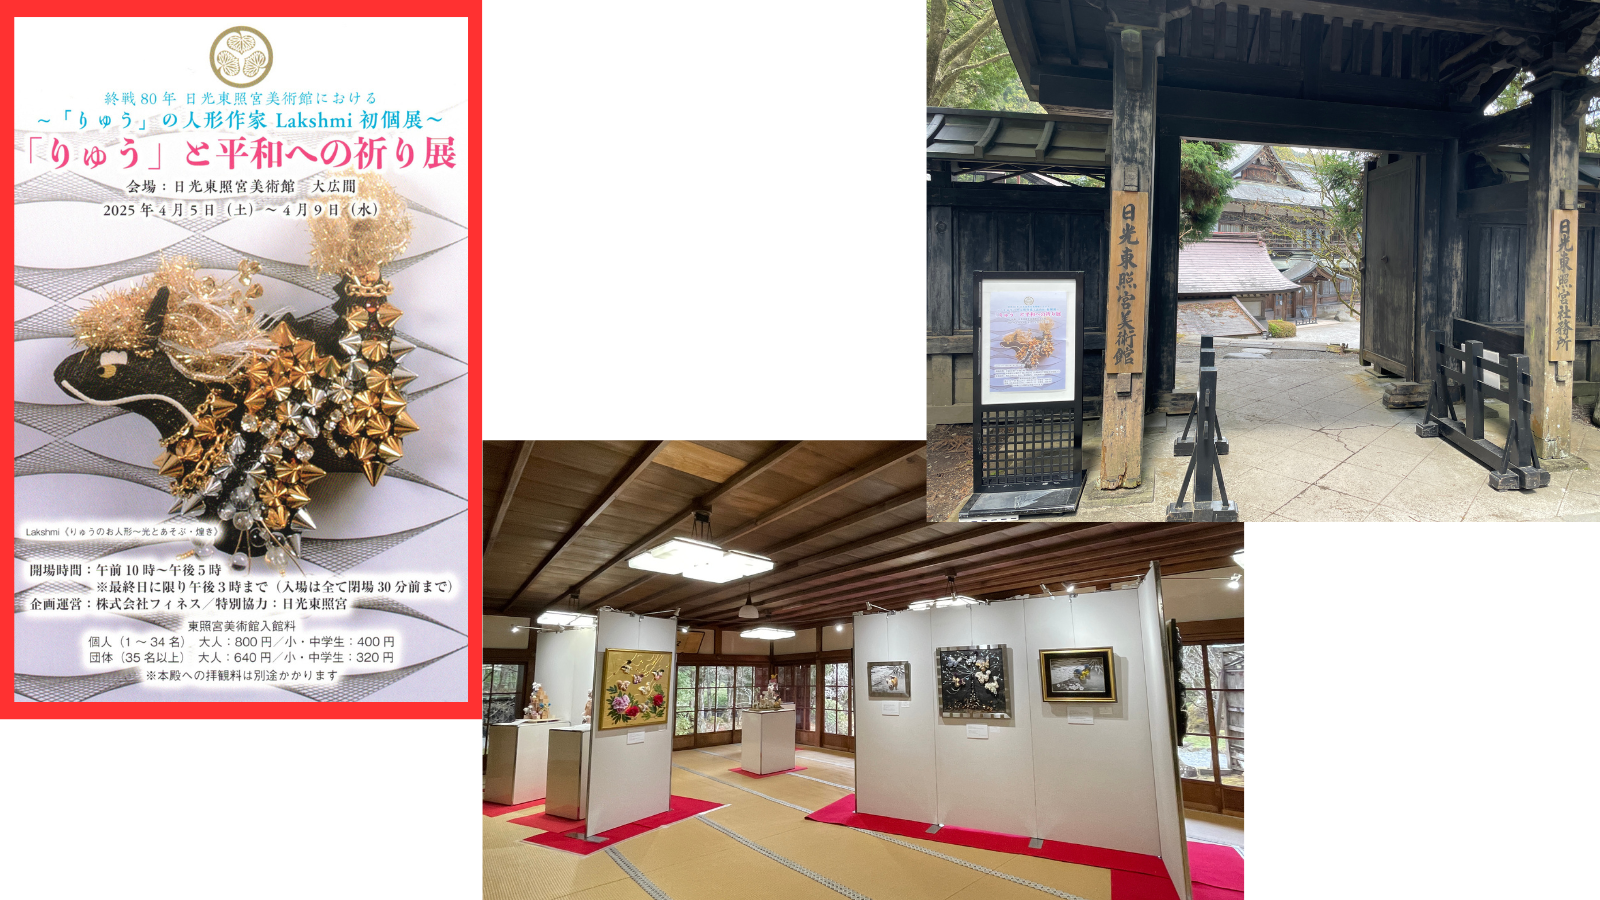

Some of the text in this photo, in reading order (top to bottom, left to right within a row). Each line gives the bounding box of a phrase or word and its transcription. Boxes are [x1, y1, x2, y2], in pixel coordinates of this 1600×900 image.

[104, 92, 377, 106] 終戦80年 日光東照宮美術館における
[276, 111, 353, 129] Lakshmi
[29, 136, 457, 170] 「りゅう」と平和への祈り展
[126, 180, 356, 194] 会場：日光東照宮美術館 大広間
[1112, 203, 1140, 366] 日光東照宮美術館
[1555, 218, 1574, 352] 日光東照宮社務所
[187, 620, 297, 633] 東照宮美術館入館料
[145, 669, 339, 682] ※本殿への拝観料は別途かかります
